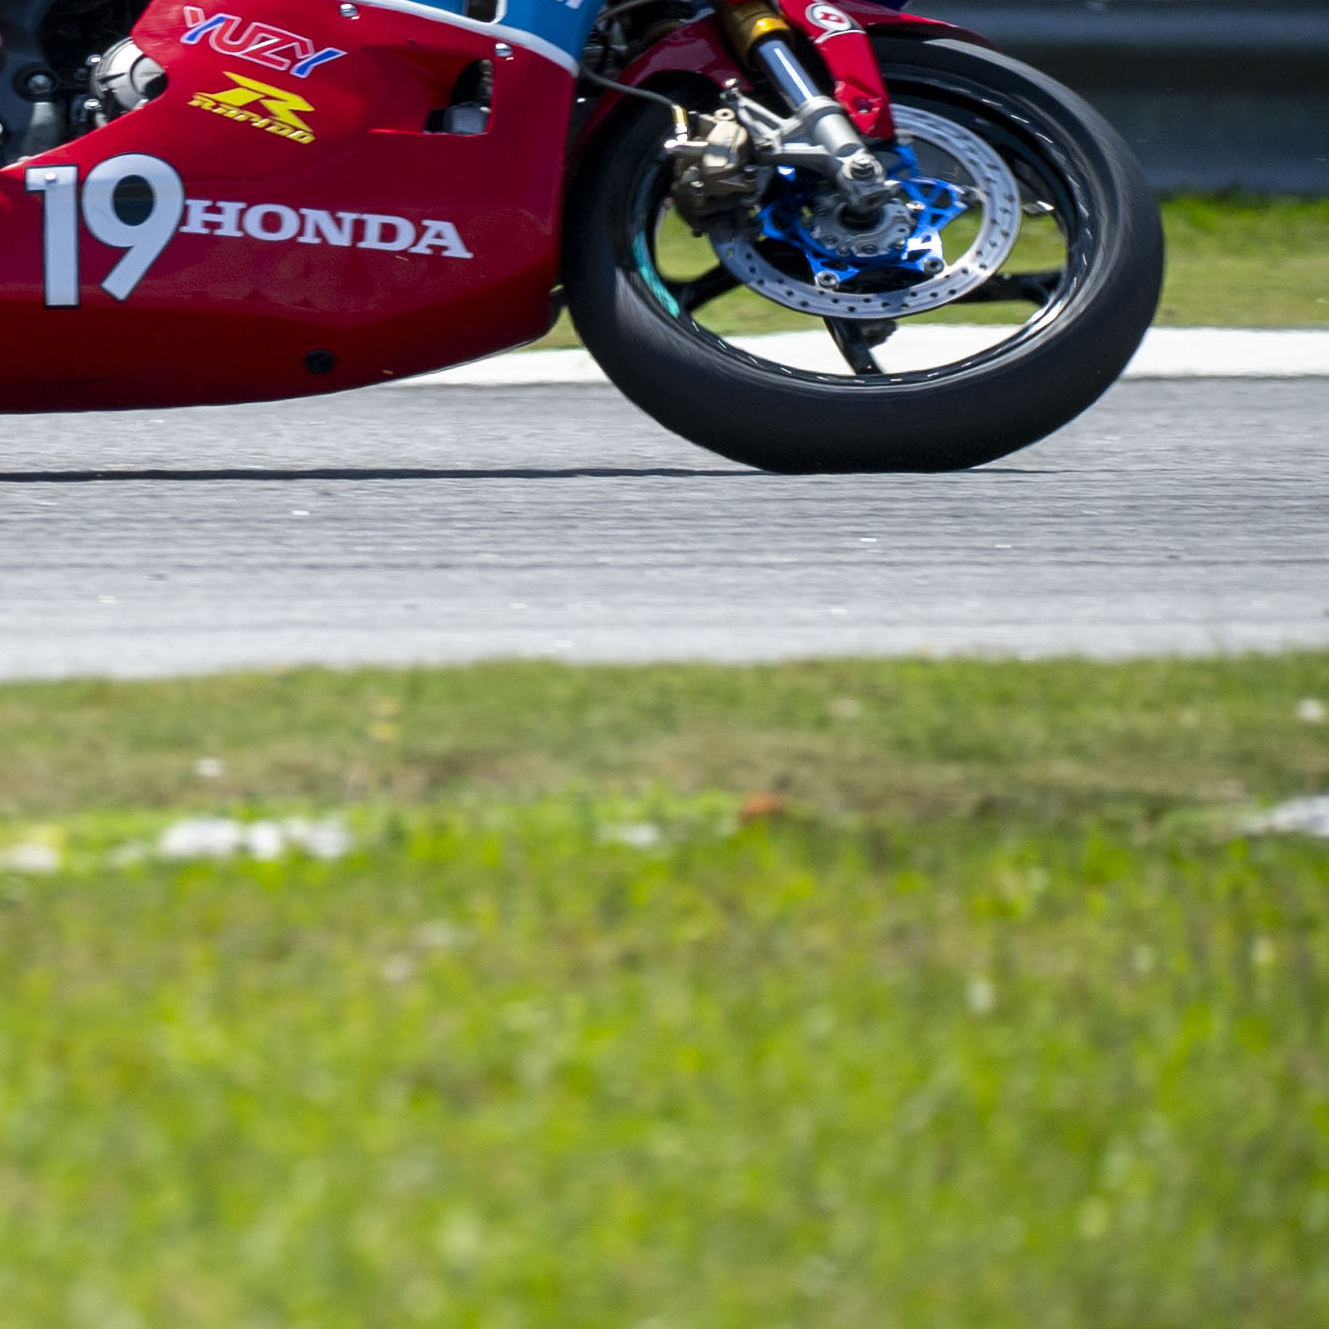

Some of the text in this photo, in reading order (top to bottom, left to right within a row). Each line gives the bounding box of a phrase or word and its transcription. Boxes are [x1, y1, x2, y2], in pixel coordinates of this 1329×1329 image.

[180, 6, 349, 79] YUZY
[187, 95, 316, 145] RAPIDO
[25, 152, 186, 309] 19
[178, 198, 474, 260] HONDA
